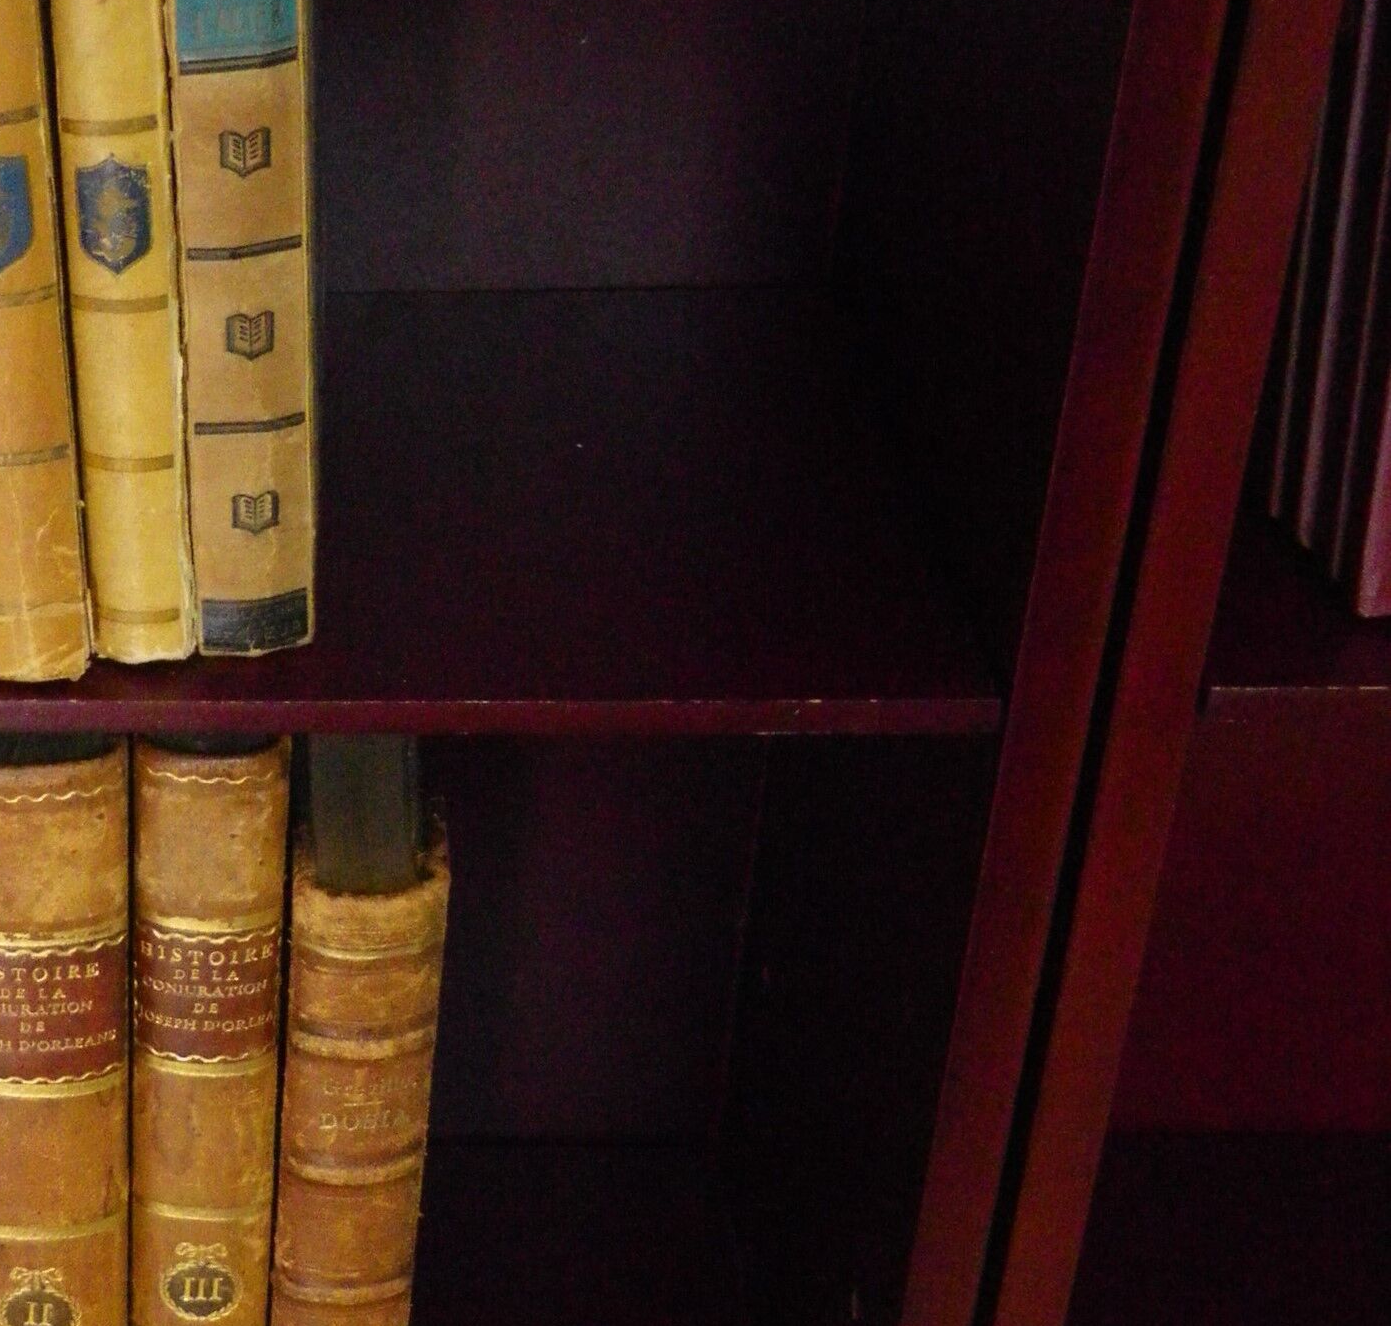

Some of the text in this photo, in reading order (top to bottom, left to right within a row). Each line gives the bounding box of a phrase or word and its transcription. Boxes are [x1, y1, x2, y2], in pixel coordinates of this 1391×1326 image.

[141, 939, 276, 965] HISTOIRE
[172, 968, 240, 982] DE LA
[0, 987, 67, 999] DE LA
[192, 1002, 219, 1015] DE
[139, 1005, 197, 1031] JOSEPH
[19, 1021, 46, 1034] DE
[182, 1275, 226, 1303] III
